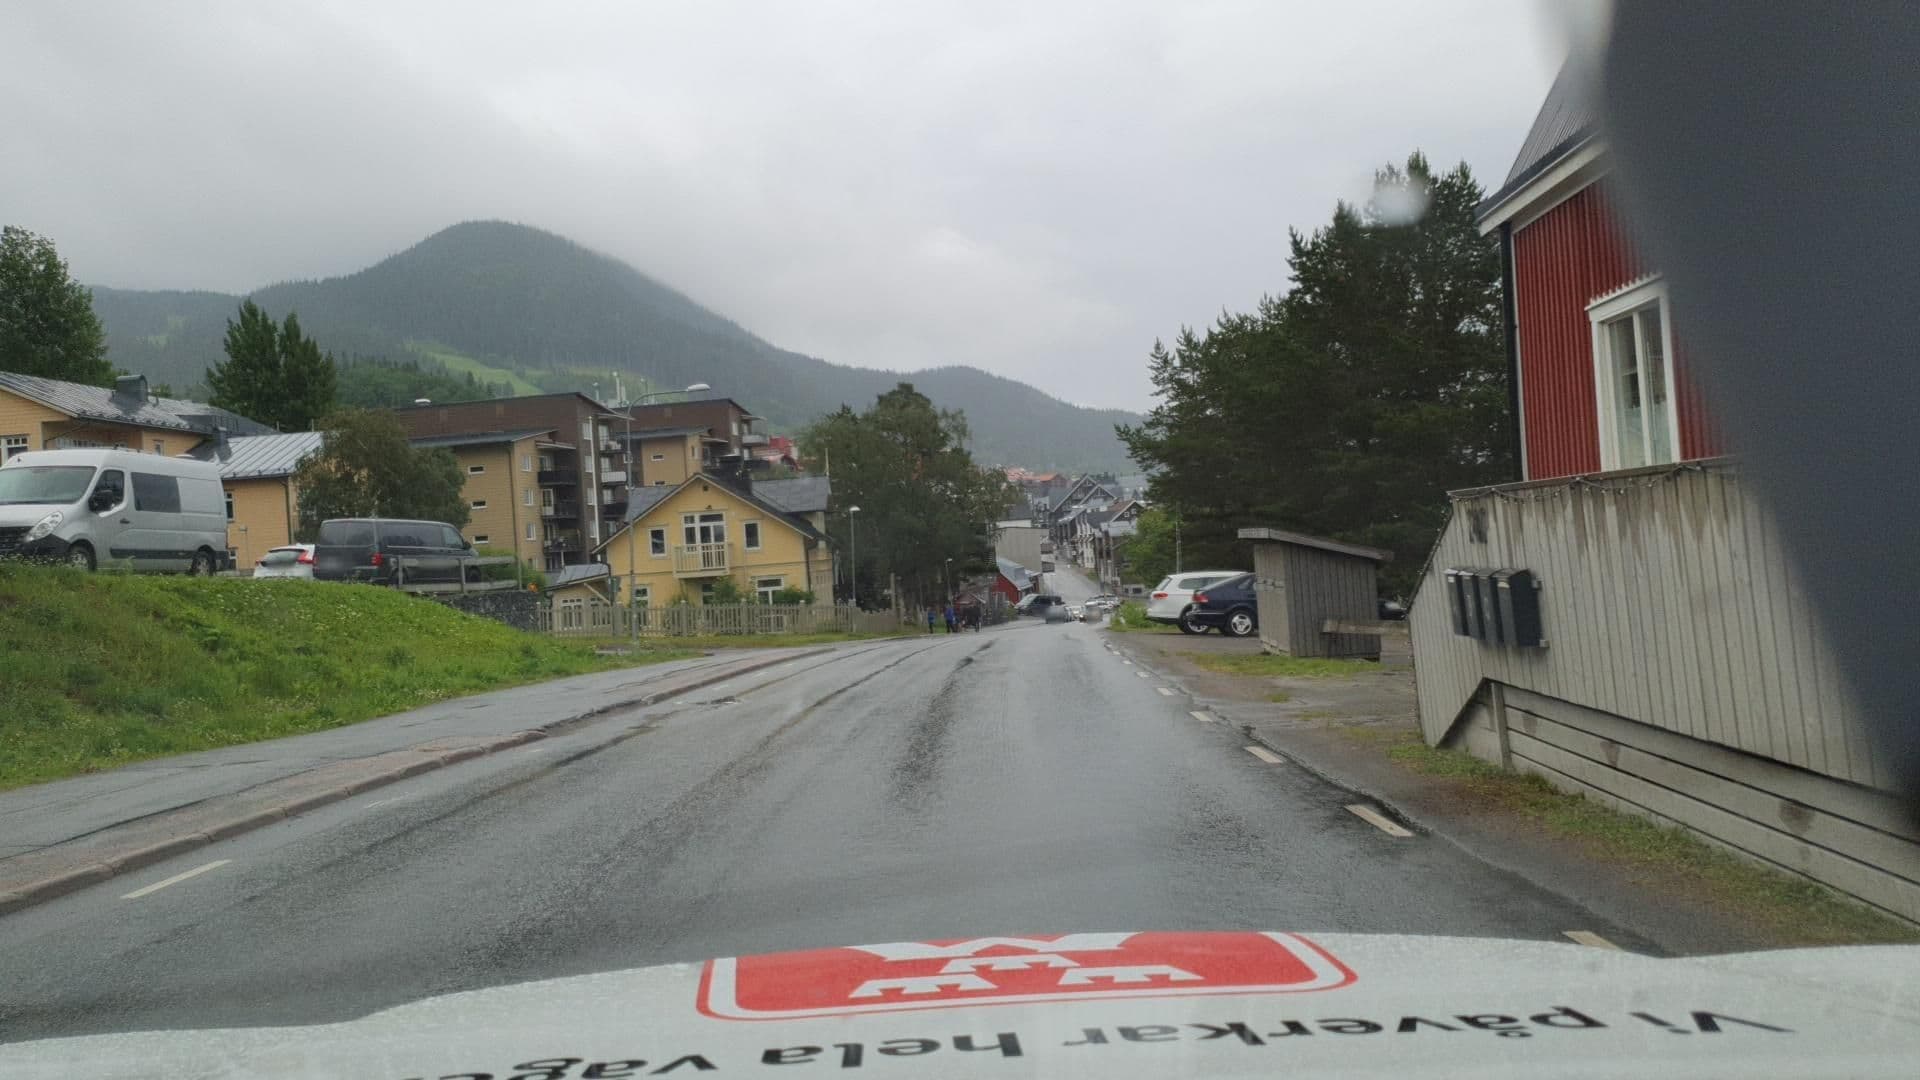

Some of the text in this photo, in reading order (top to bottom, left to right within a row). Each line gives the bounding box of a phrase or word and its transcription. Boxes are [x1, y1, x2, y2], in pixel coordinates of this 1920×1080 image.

[1063, 1005, 1608, 1046] påverkar
[1628, 1010, 1796, 1034] Vi
[761, 1032, 1024, 1068] hela
